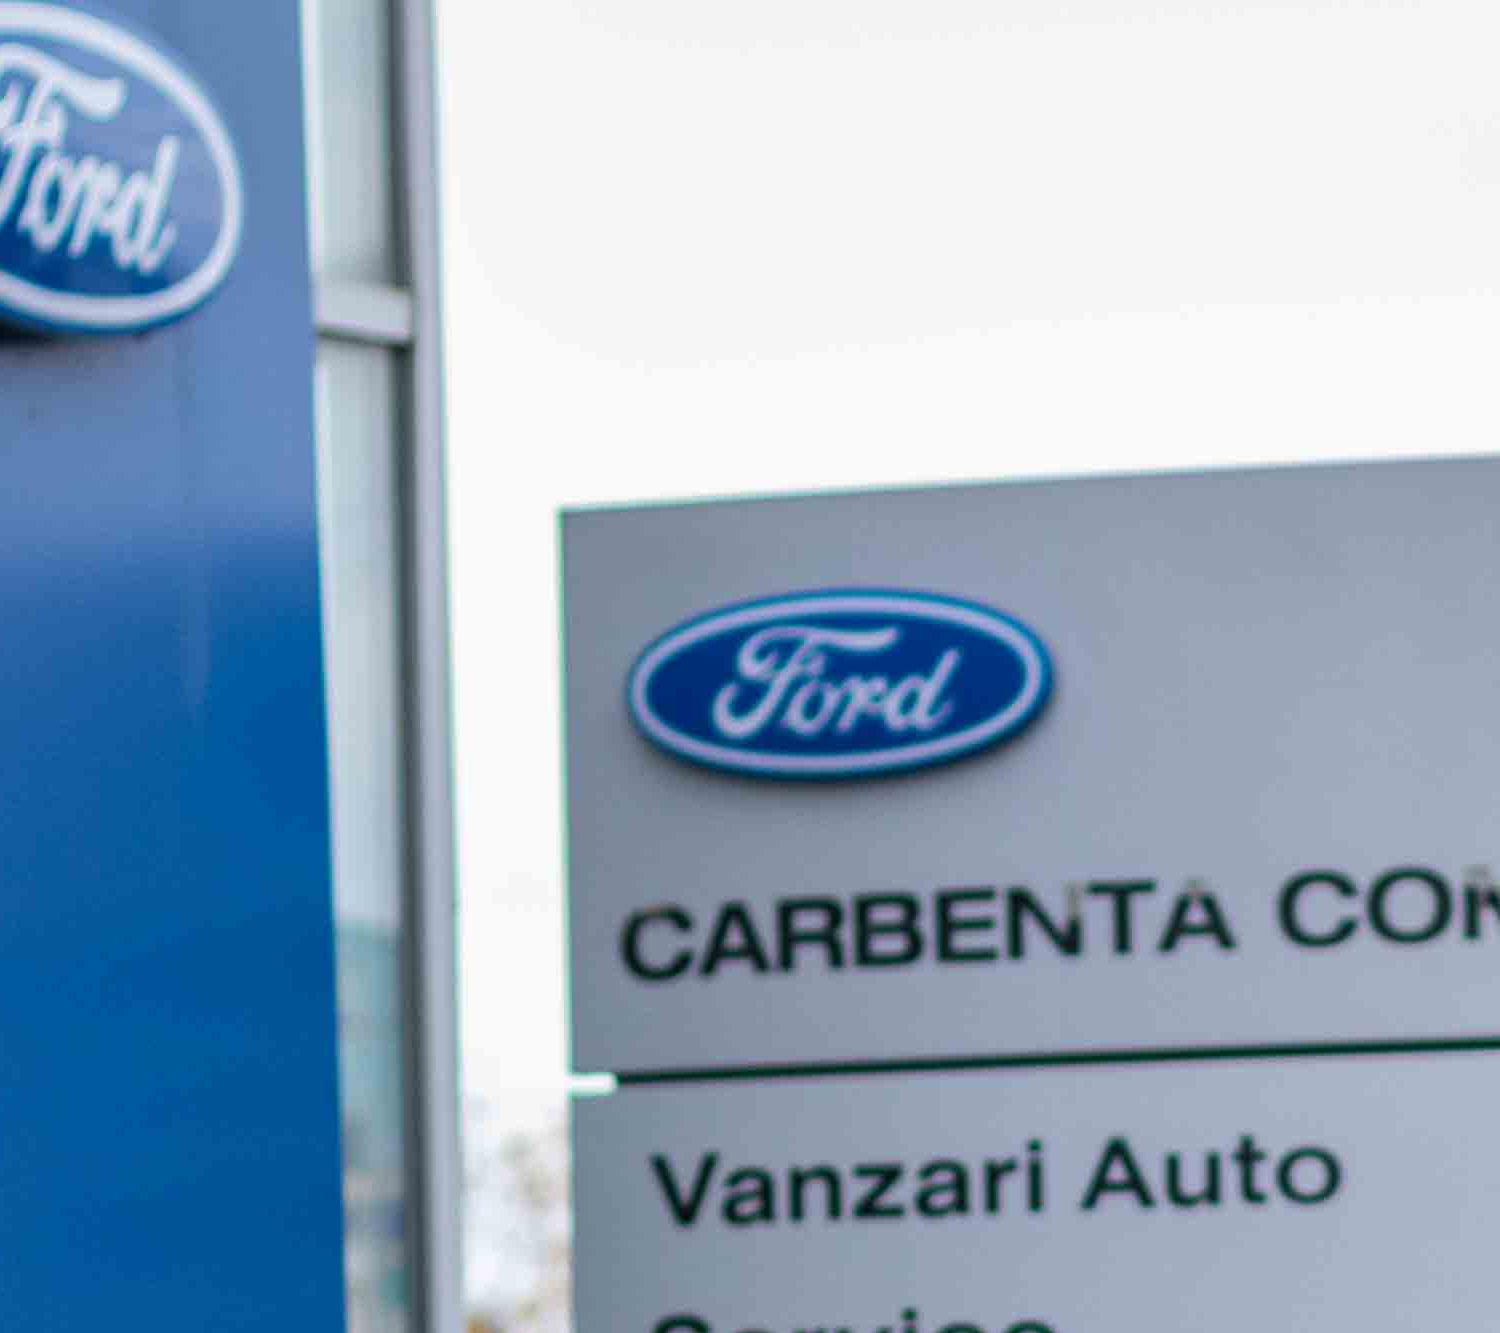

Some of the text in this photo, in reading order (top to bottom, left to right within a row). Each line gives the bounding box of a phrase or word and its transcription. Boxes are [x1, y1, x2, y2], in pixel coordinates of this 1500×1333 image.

[713, 625, 962, 737] Ford
[617, 876, 1238, 983] CARBENTA
[649, 1134, 1343, 1228] Vanzari Auto
